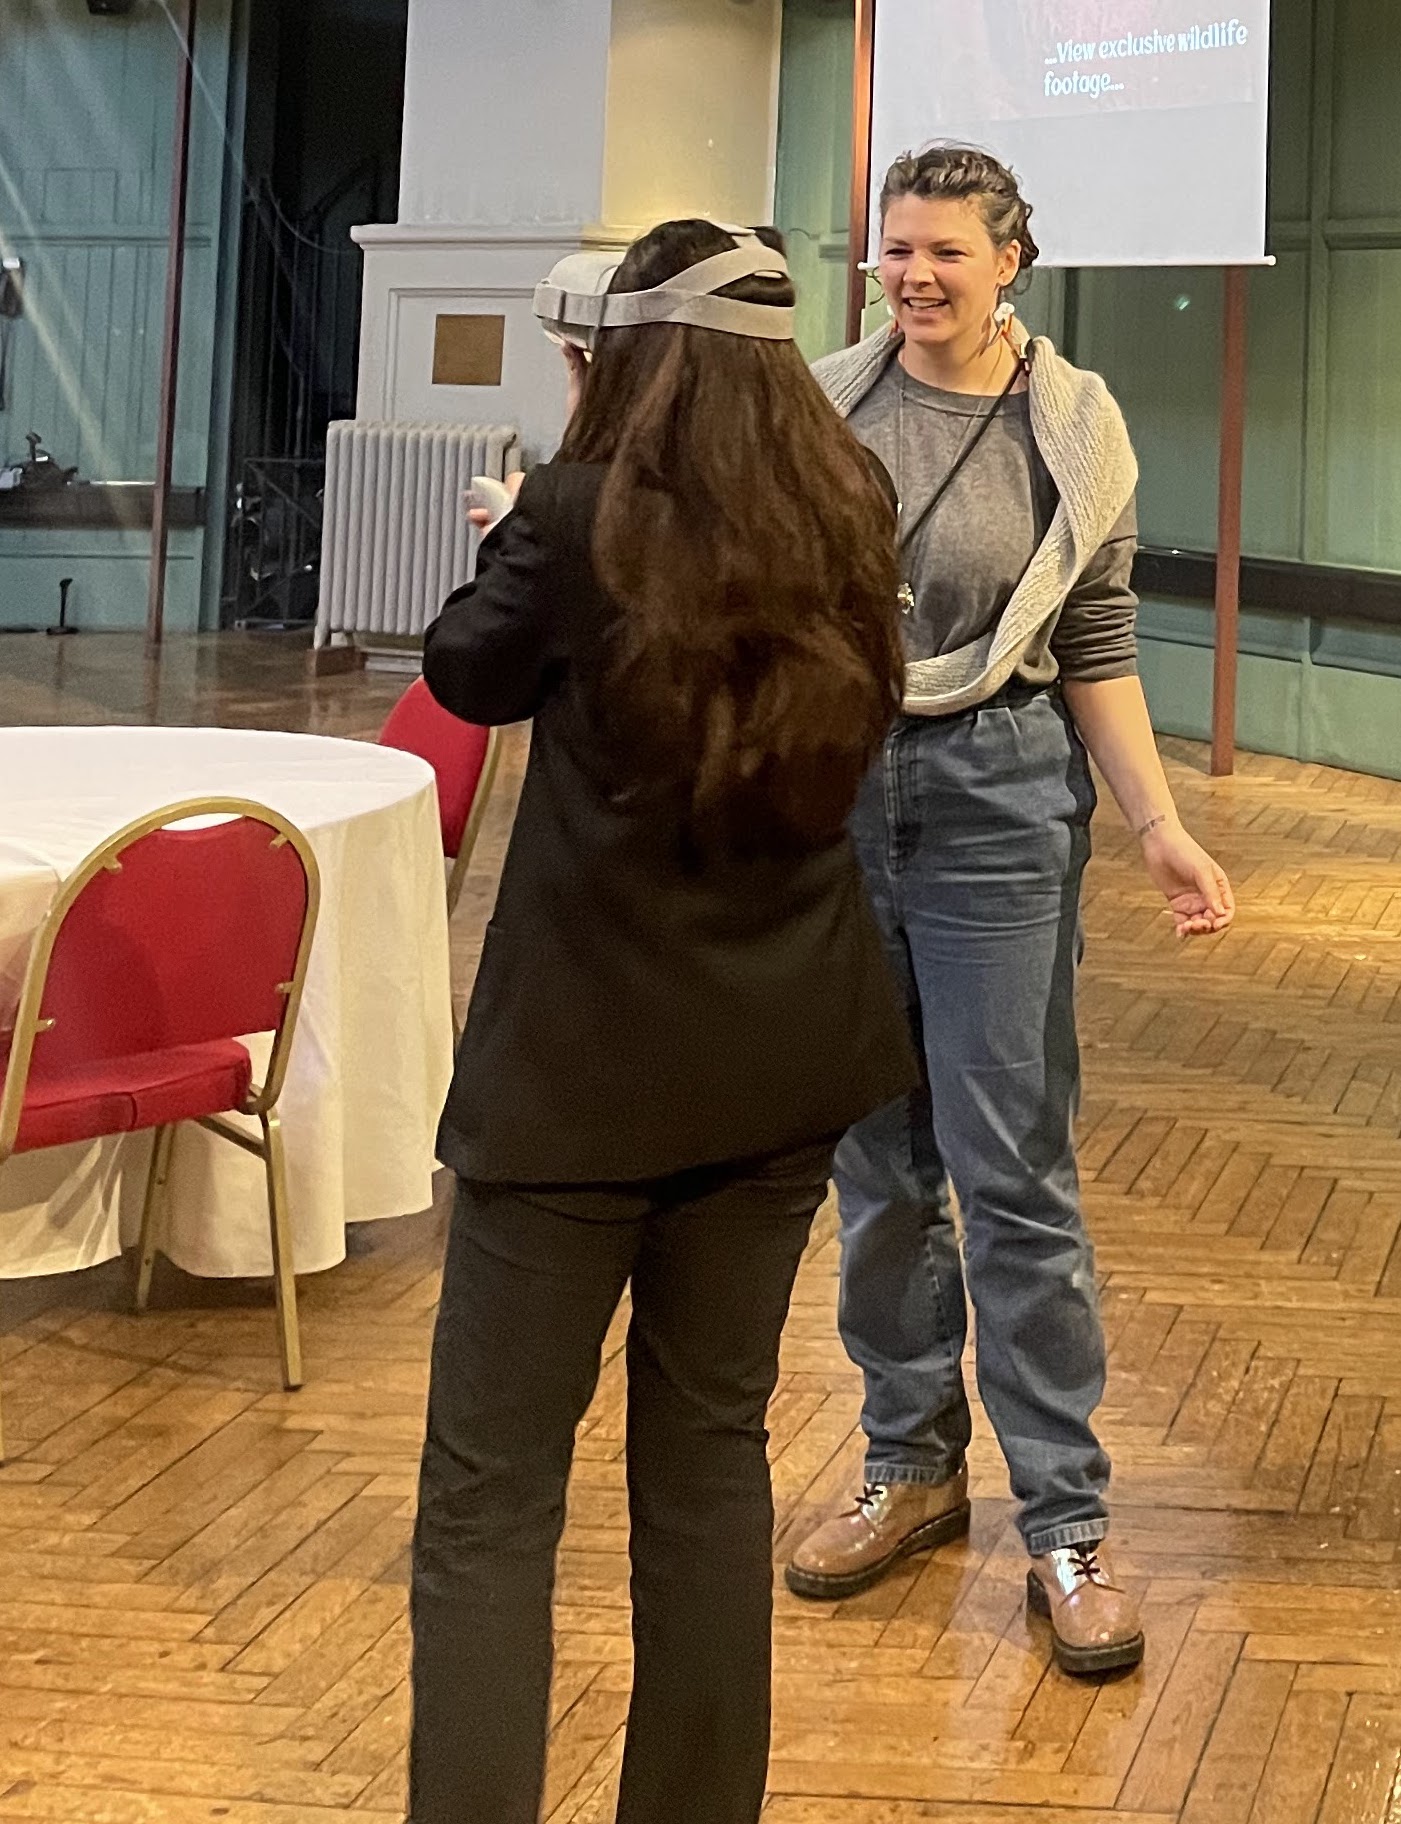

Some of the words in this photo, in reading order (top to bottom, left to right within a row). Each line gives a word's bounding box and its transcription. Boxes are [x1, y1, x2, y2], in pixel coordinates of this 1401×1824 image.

[1099, 29, 1175, 59] exclusive
[1178, 18, 1248, 52] wildlife
[1044, 70, 1124, 98] footage...
